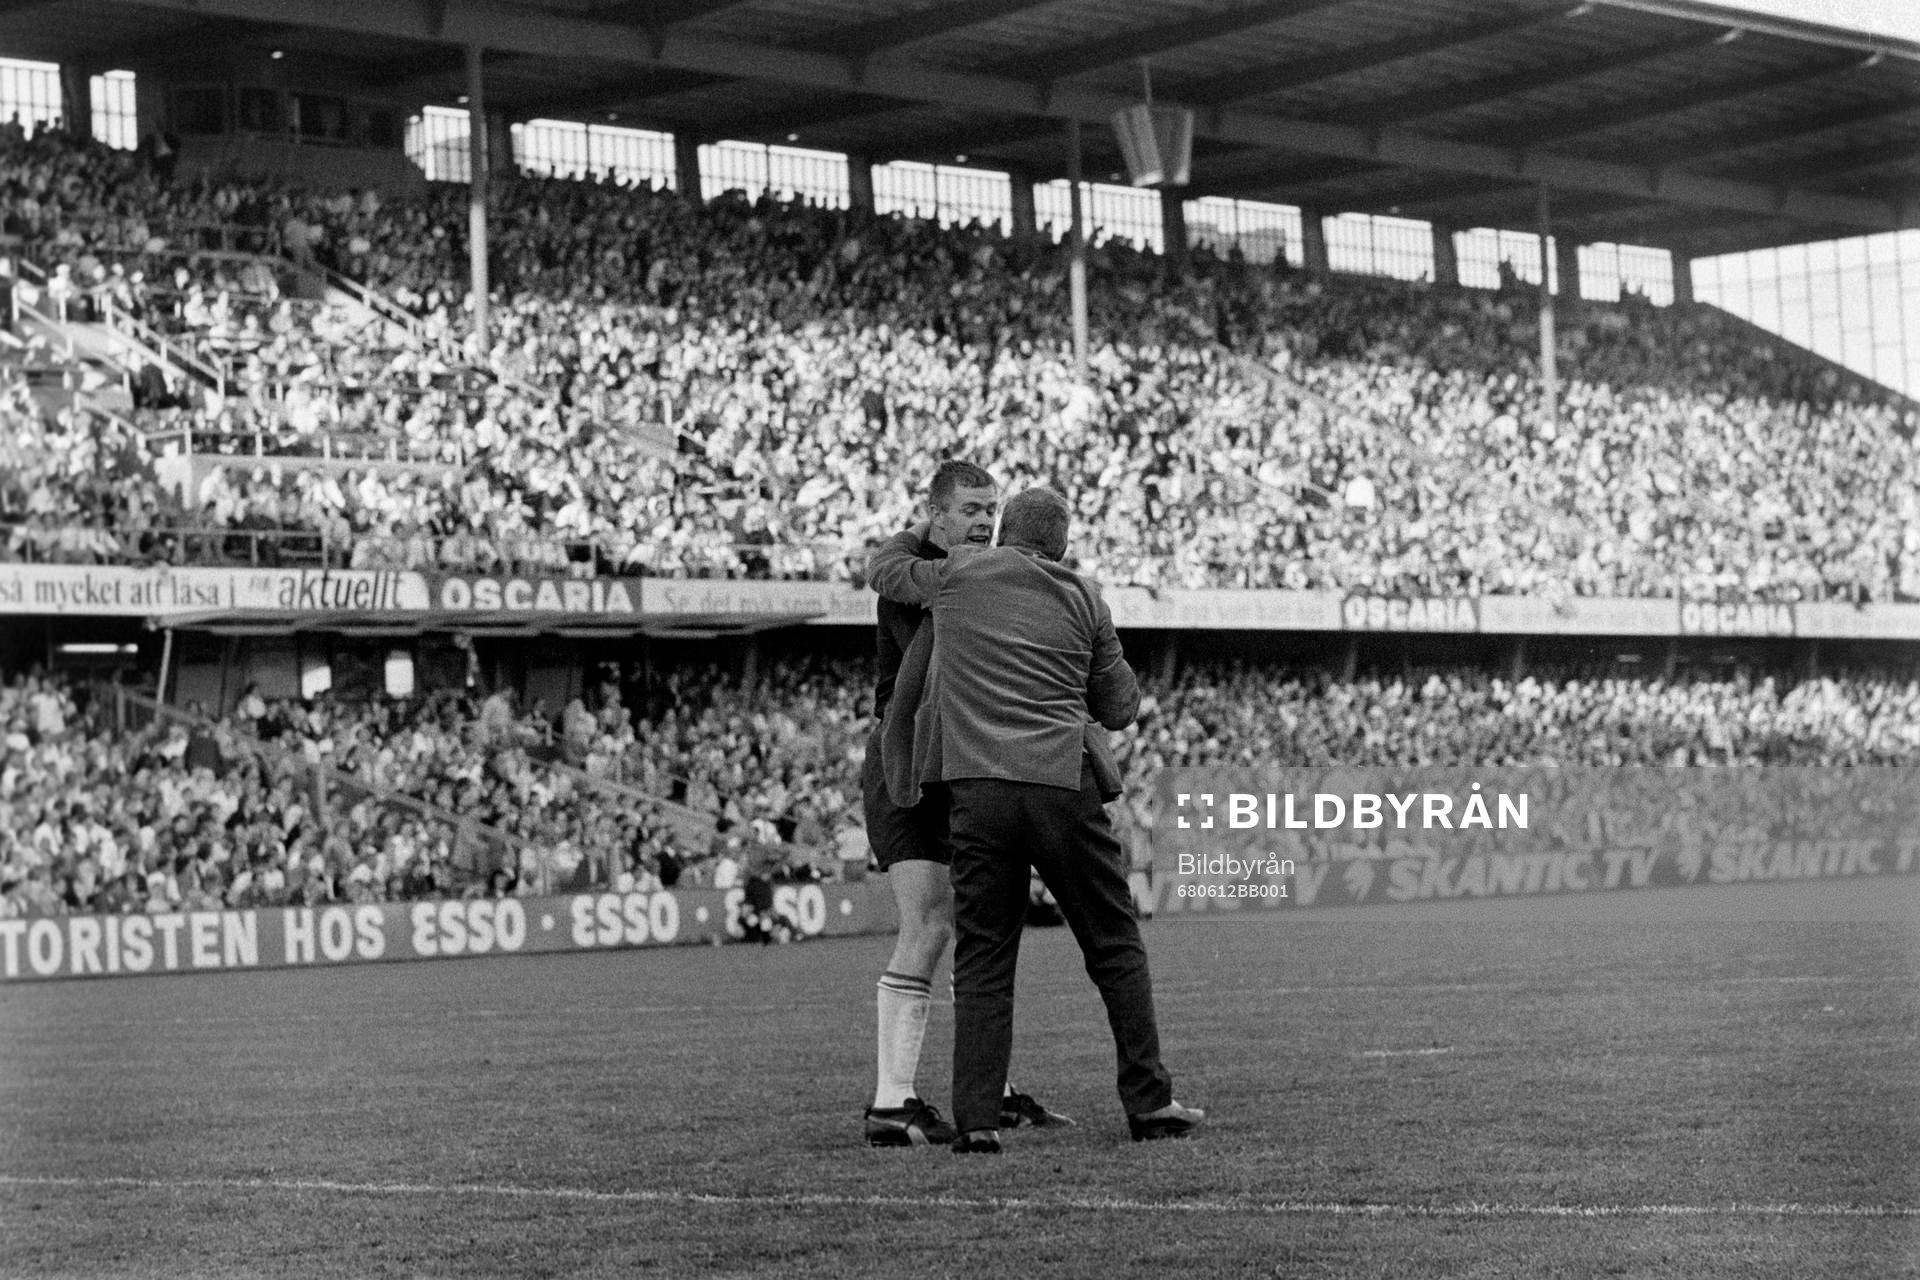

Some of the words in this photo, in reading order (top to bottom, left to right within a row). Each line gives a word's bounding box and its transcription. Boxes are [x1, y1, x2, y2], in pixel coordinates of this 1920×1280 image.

[34, 572, 121, 612] mycket
[278, 568, 407, 611] aktuellt
[439, 578, 634, 613] OSCARIA
[1345, 595, 1478, 630] OSCARIA
[1682, 603, 1794, 636] OSCARIA
[1388, 852, 1594, 900] SKANTIC
[1604, 848, 1658, 888] TV
[1709, 838, 1882, 883] SKANTIC
[570, 891, 679, 947] ESSO
[725, 885, 826, 938] ESO
[0, 910, 259, 977] TORISTEN
[283, 906, 386, 963] HOS
[411, 899, 527, 956] ESSO
